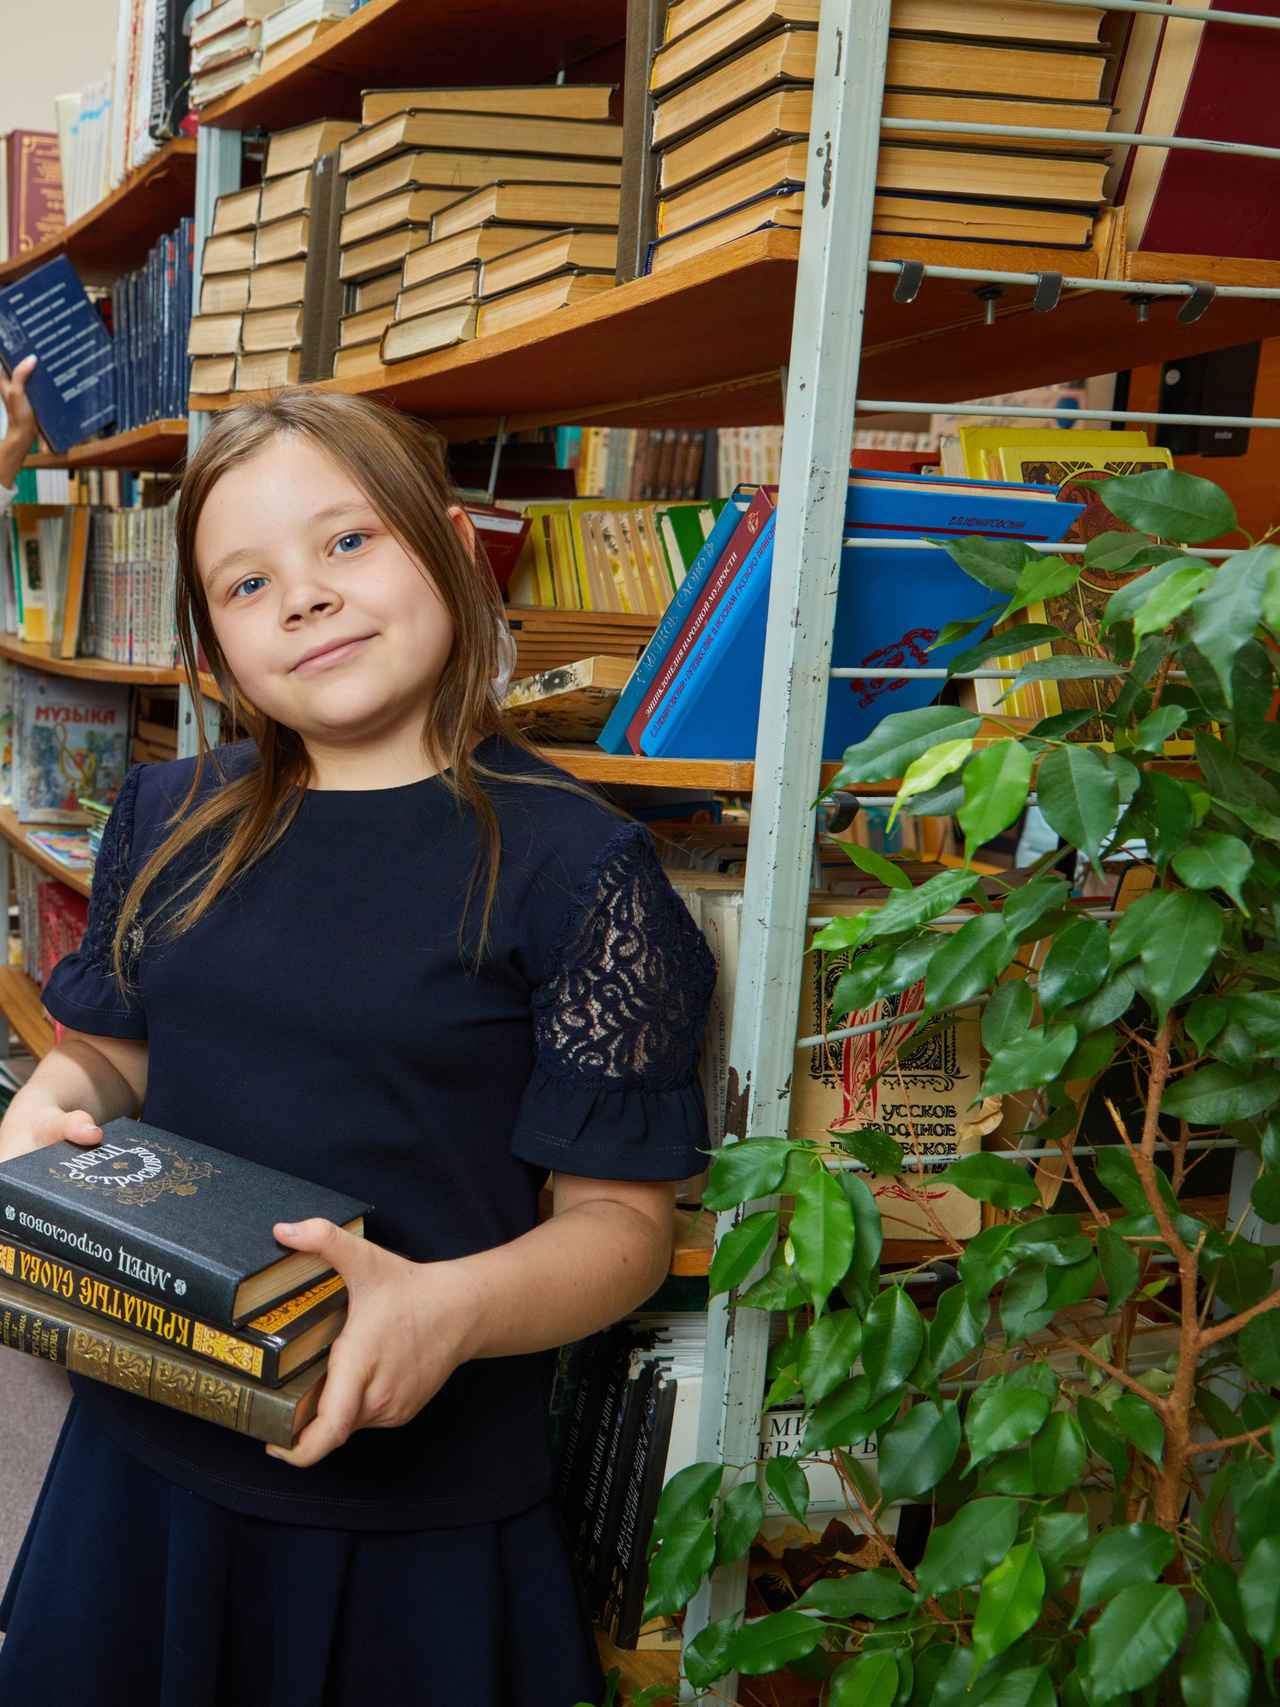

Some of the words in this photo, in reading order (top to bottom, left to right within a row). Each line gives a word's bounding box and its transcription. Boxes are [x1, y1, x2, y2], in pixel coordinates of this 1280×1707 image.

[35, 705, 117, 725] МУЗЫКА
[60, 1143, 131, 1173] ЛАРЕЦ
[19, 1250, 74, 1299] СЛОВА
[118, 1245, 172, 1291] ЛАРЕЦ
[78, 1276, 191, 1347] КРЫЛАТЫЕ
